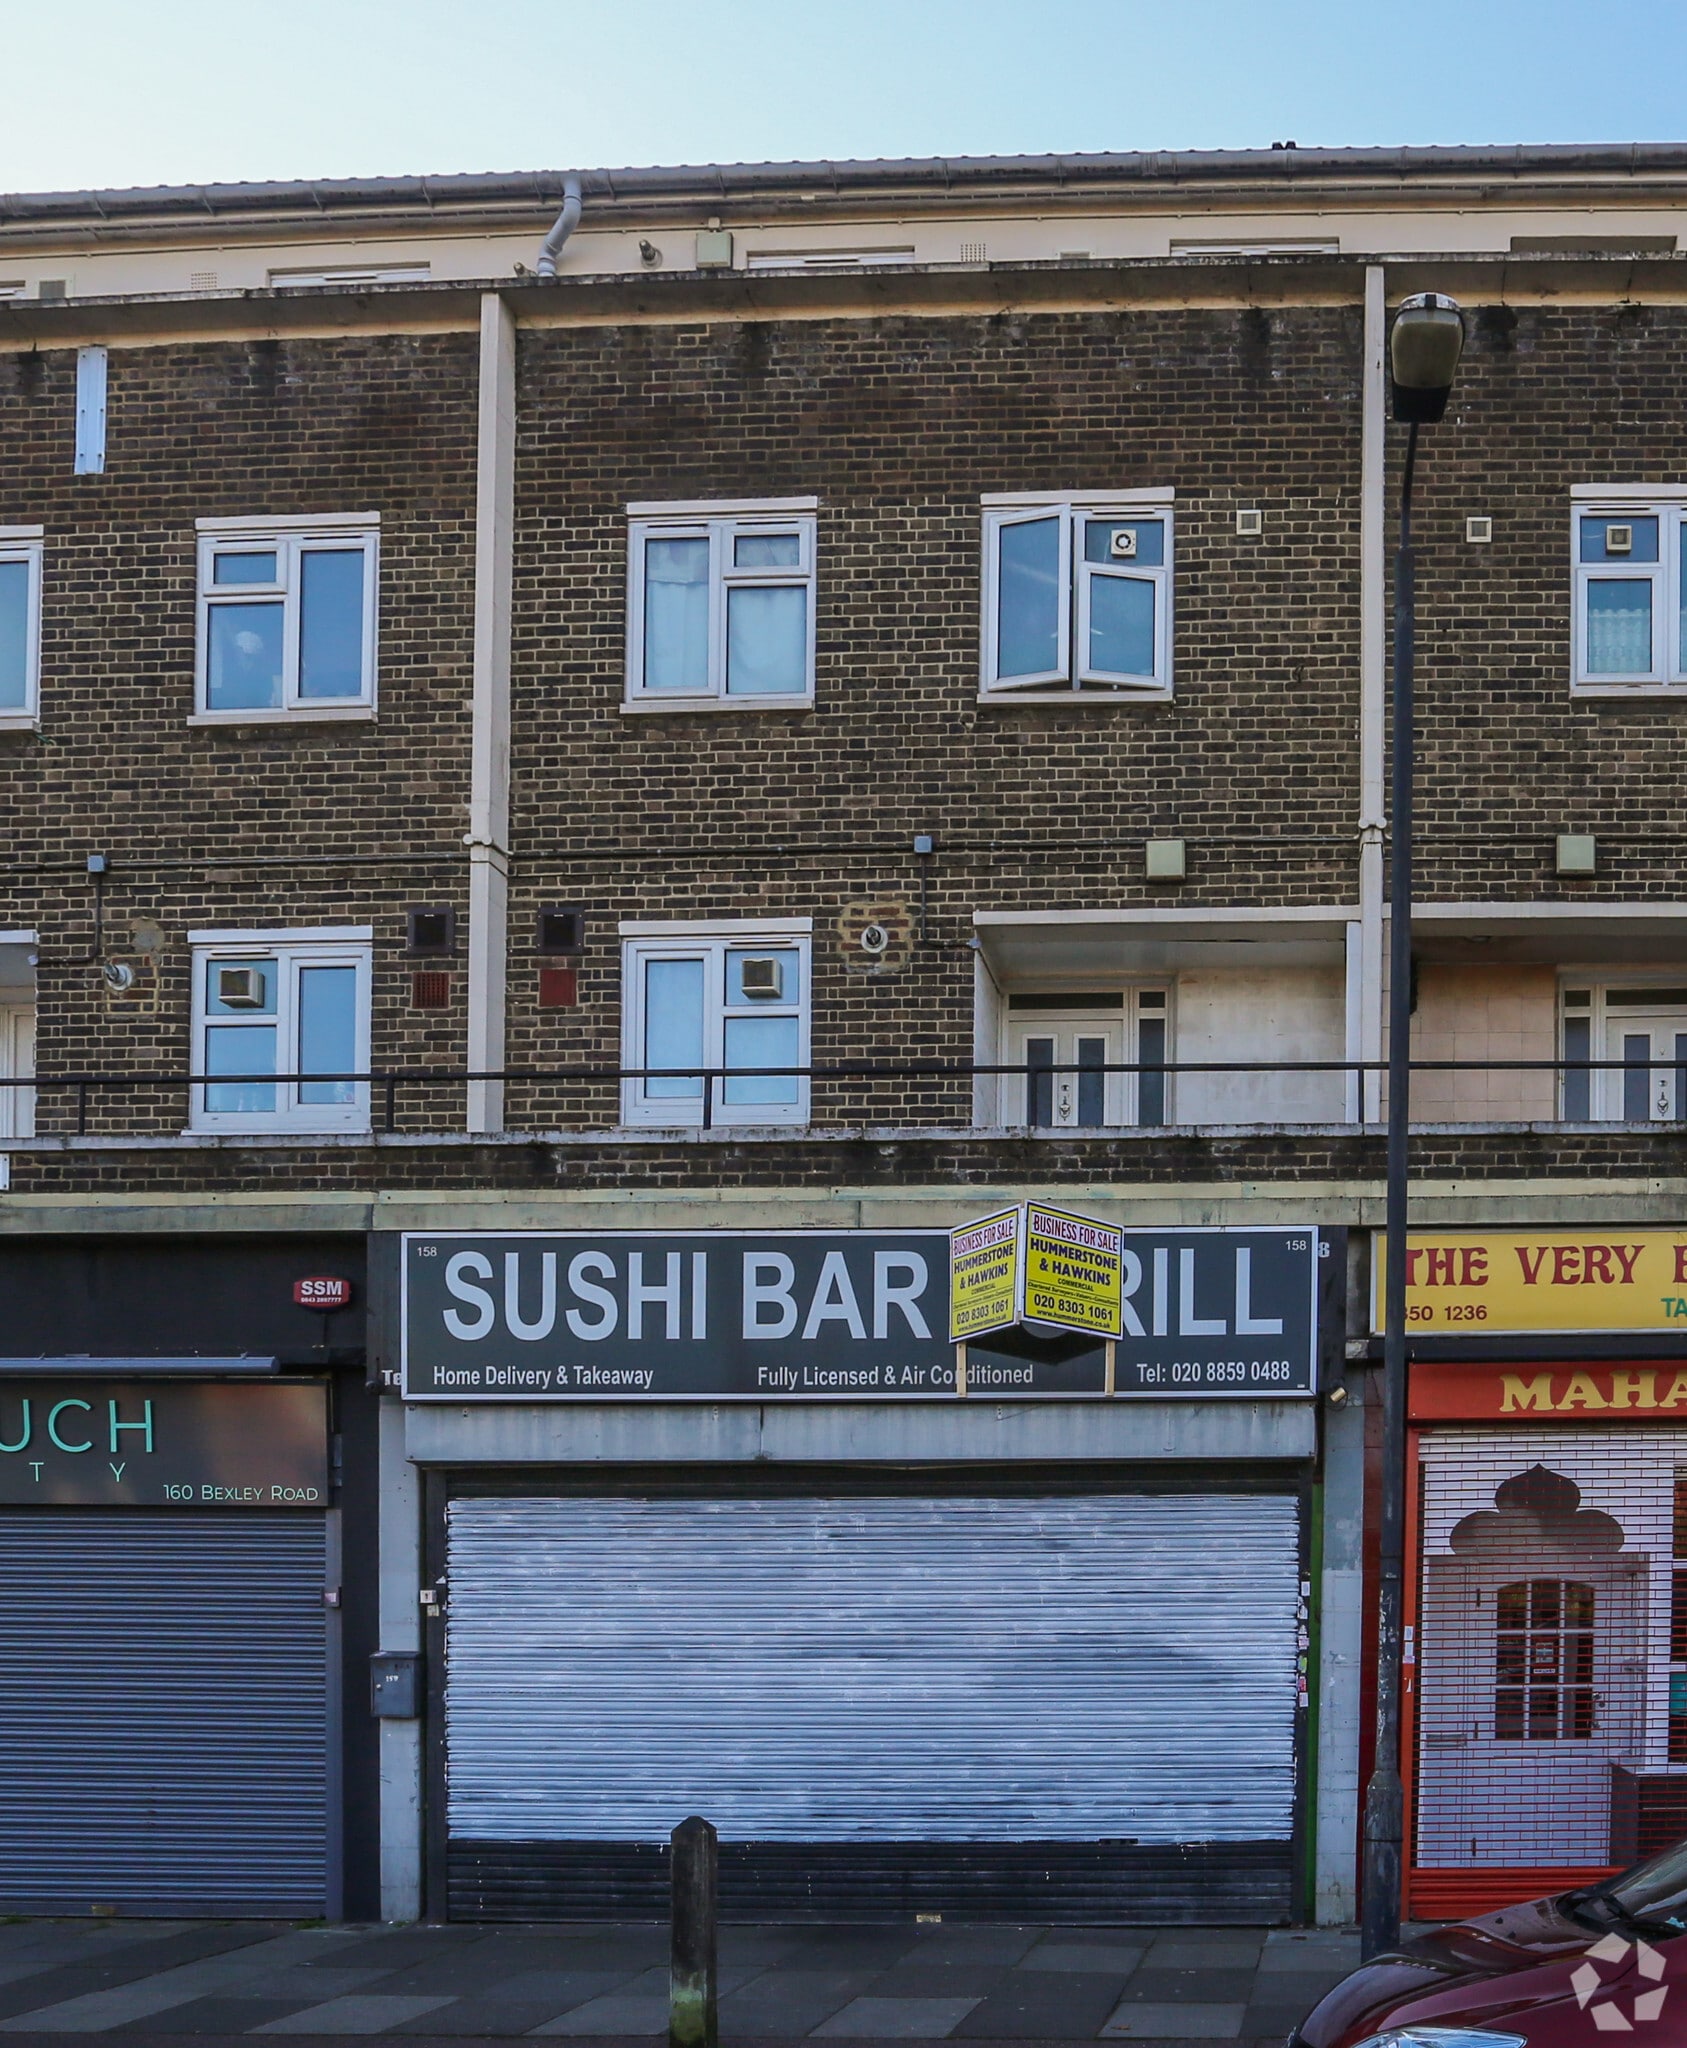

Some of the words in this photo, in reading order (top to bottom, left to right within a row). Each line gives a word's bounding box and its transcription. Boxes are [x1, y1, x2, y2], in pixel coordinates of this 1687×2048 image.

[953, 1229, 983, 1255] BUSINESS
[984, 1225, 996, 1245] FOR
[997, 1220, 1013, 1241] SALE
[1033, 1214, 1077, 1240] BUSINESS
[1080, 1226, 1095, 1246] FOR
[1098, 1232, 1118, 1251] SALE
[1286, 1240, 1306, 1251] 158
[417, 1246, 437, 1257] 158
[954, 1243, 1014, 1274] HUMMERSTONE
[1030, 1238, 1117, 1270] HUMMERSTONE
[960, 1277, 966, 1289] &
[968, 1263, 1008, 1287] HAWKINS
[1039, 1258, 1049, 1271] &
[1053, 1260, 1111, 1286] HAWKINS
[1405, 1247, 1489, 1286] THE
[1514, 1244, 1646, 1285] VERY
[301, 1281, 342, 1295] SSM
[442, 1250, 707, 1341] SUSHI
[742, 1250, 933, 1339] BAR
[1058, 1278, 1094, 1292] COMMERCIAL
[957, 1311, 969, 1324] 020
[972, 1305, 989, 1320] 8303
[992, 1299, 1008, 1314] 1061
[1034, 1294, 1054, 1309] 020
[1058, 1299, 1084, 1315] 8303
[1089, 1305, 1112, 1321] 1061
[1404, 1305, 1434, 1321] 50
[1444, 1305, 1488, 1320] 1236
[433, 1366, 480, 1385] Home
[485, 1365, 551, 1389] Delivery
[556, 1365, 568, 1385] &
[573, 1366, 654, 1389] Takeaway
[758, 1366, 798, 1391] Fully
[803, 1366, 879, 1386] Licensed
[884, 1366, 896, 1385] &
[901, 1365, 925, 1385] Air
[1136, 1363, 1166, 1383] Tel:
[1171, 1362, 1201, 1382] 020
[1206, 1361, 1245, 1381] 8859
[1251, 1360, 1290, 1381] 0488
[163, 1484, 193, 1500] 160
[201, 1485, 264, 1500] BEXLEY
[271, 1485, 319, 1500] ROAD
